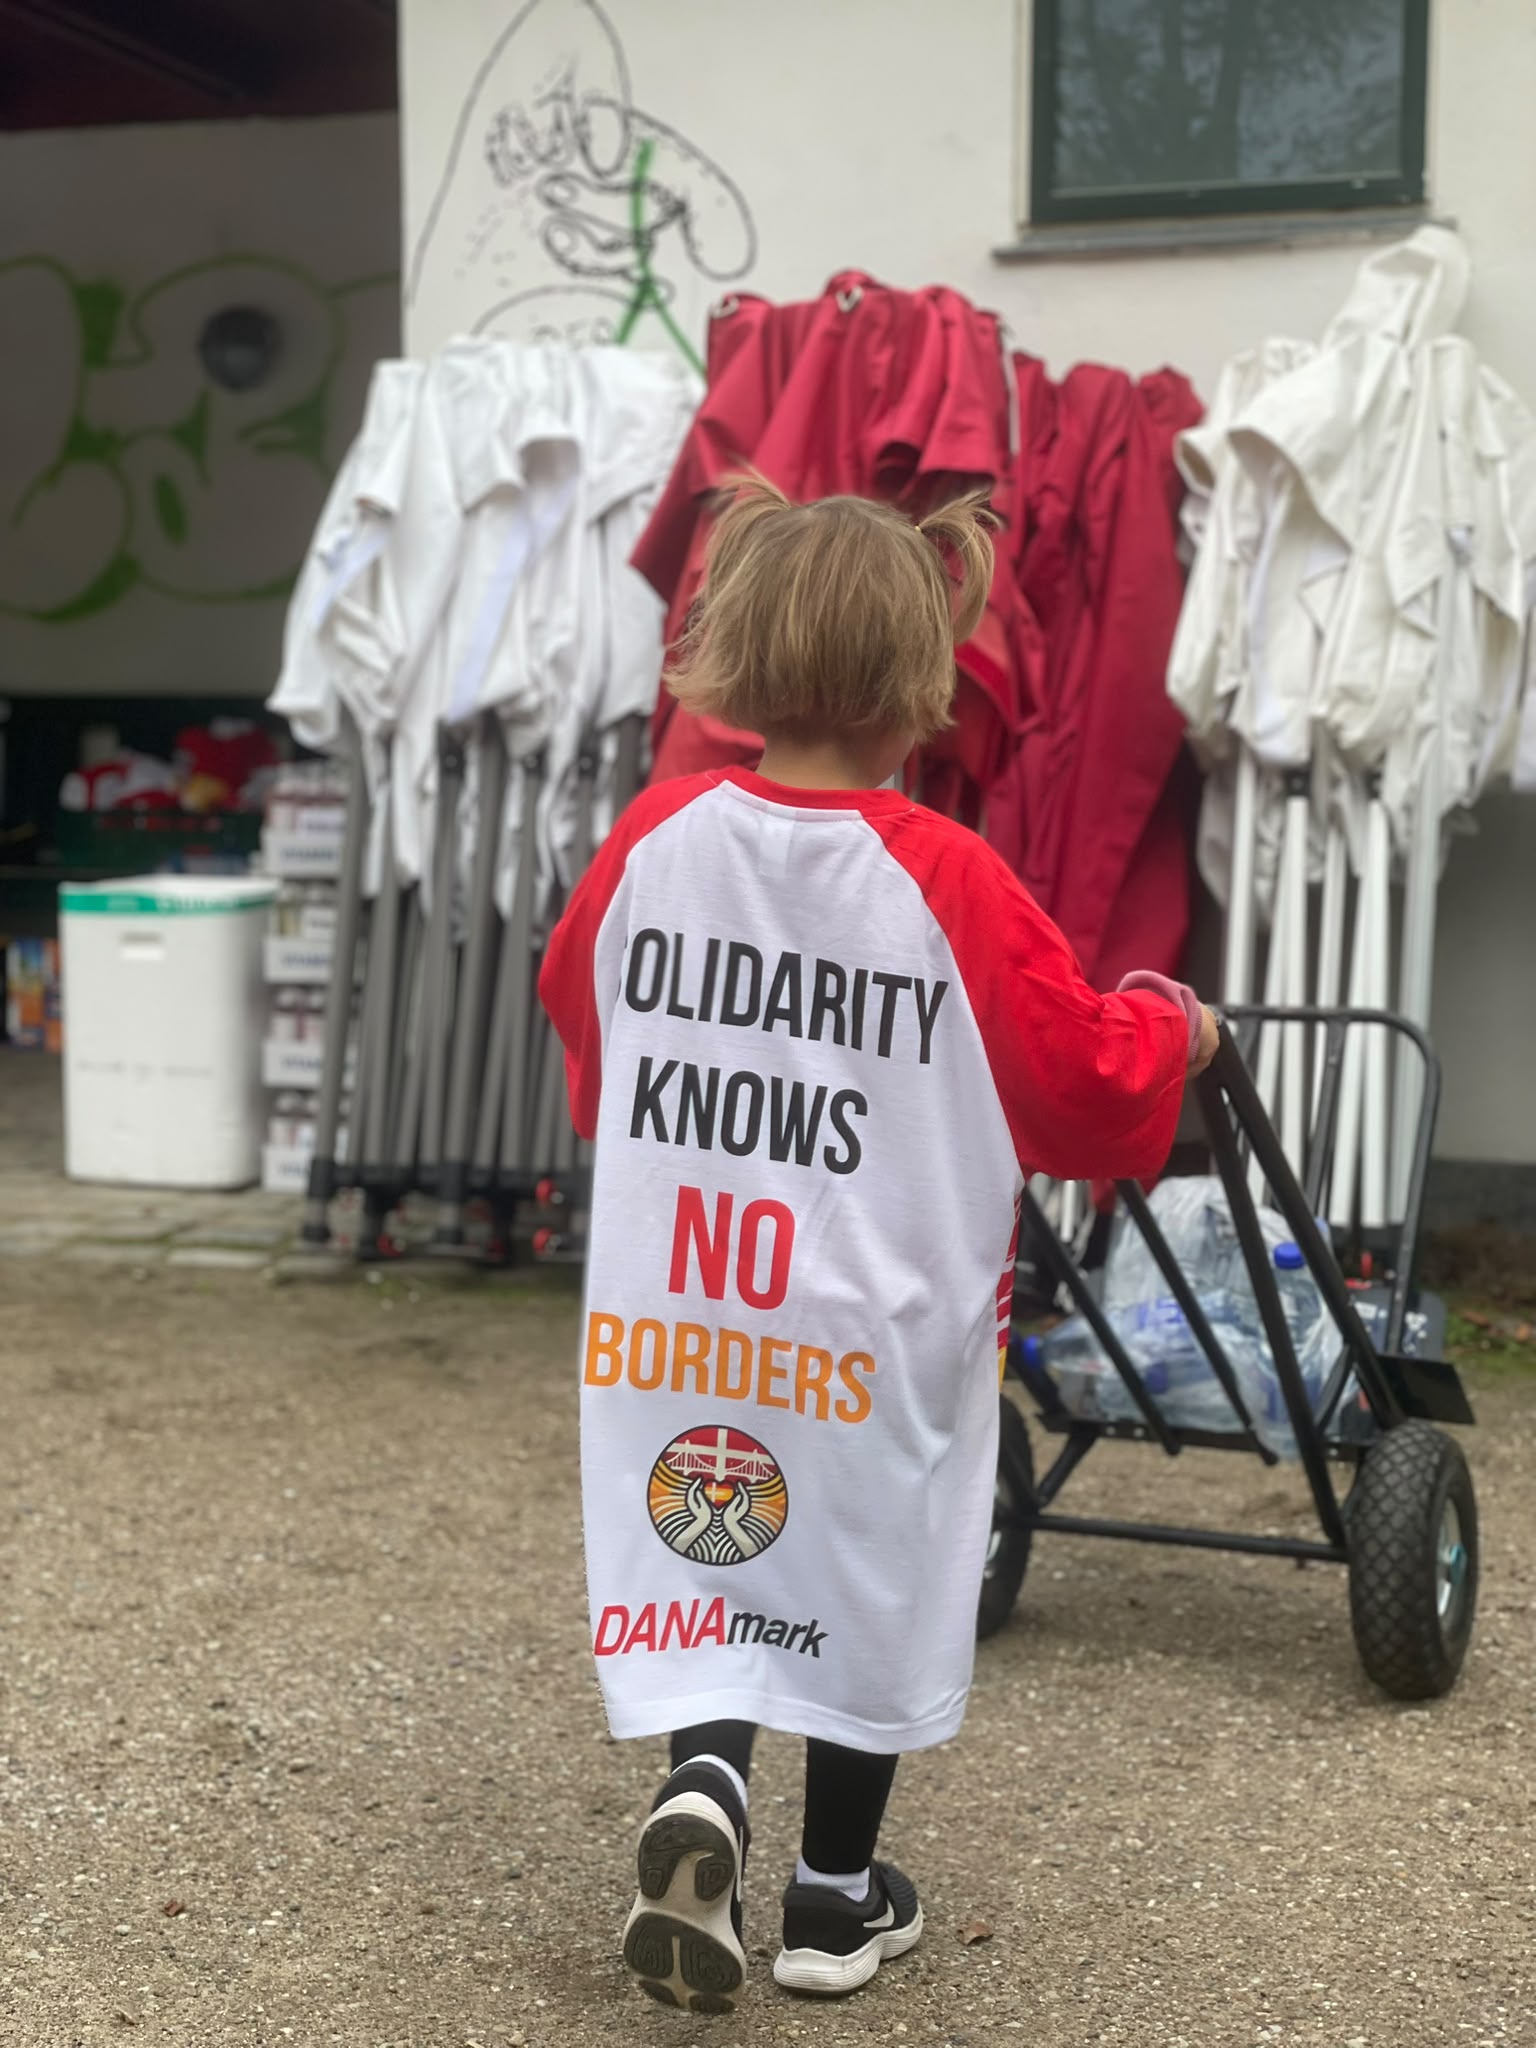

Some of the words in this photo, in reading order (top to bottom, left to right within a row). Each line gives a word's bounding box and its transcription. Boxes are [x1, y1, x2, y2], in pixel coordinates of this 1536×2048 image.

[617, 927, 949, 1065] OLIDARITY
[629, 1055, 868, 1175] KNOWS
[668, 1185, 795, 1311] NO
[584, 1311, 876, 1424] BORDERS
[594, 1597, 829, 1659] DANAmark
